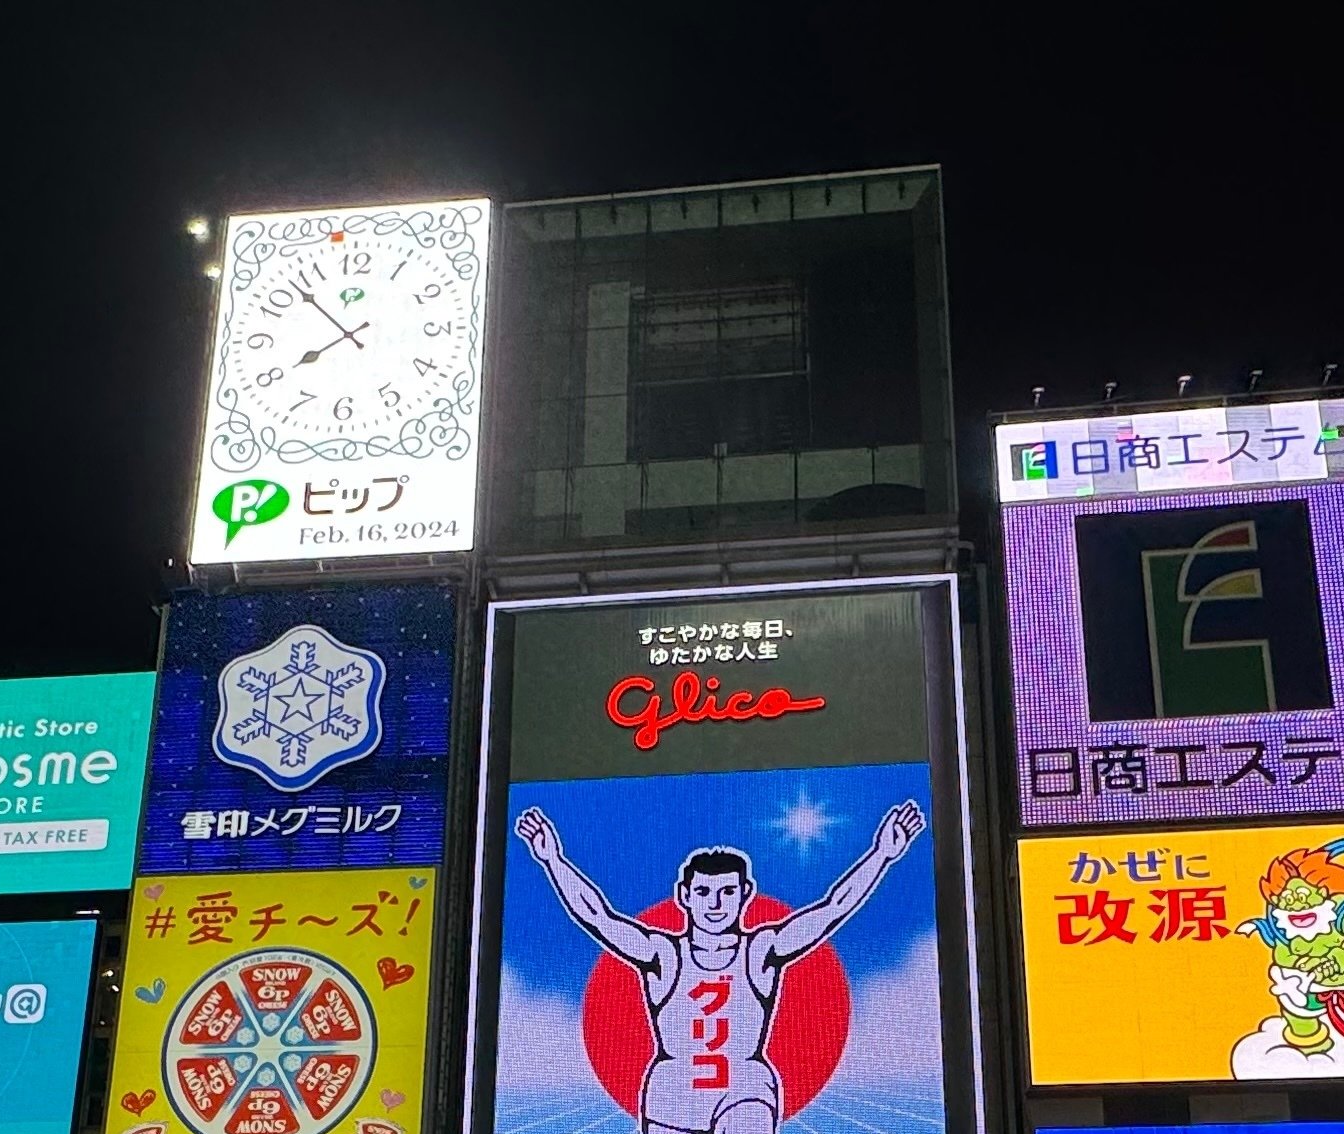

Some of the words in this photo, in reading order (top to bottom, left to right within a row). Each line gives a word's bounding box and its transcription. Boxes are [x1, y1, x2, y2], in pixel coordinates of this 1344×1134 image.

[297, 262, 326, 288] 11
[339, 252, 372, 275] 12
[390, 261, 407, 281] 1
[260, 289, 294, 318] 10
[413, 284, 441, 305] 2
[247, 332, 274, 349] 9
[424, 321, 452, 337] 3
[256, 367, 284, 387] 8
[413, 357, 437, 377] 4
[289, 391, 318, 412] 7
[378, 382, 401, 407] 5
[332, 397, 354, 420] 6
[303, 474, 410, 515] ピップ
[299, 527, 350, 545] Feb.
[357, 523, 388, 542] 16,
[395, 520, 460, 539] 2024
[638, 620, 794, 646] すこやかな毎日、
[648, 642, 779, 665] ゆたかな人生
[606, 671, 826, 750] Glico
[34, 718, 98, 738] Store
[181, 804, 402, 840] 雪印メグミルク
[3, 831, 39, 846] TAX
[44, 829, 88, 844] FREE
[1068, 848, 1212, 885] かぜに
[1054, 884, 1232, 947] 改源
[252, 967, 301, 982] SNOW
[688, 973, 734, 1090] グリコ
